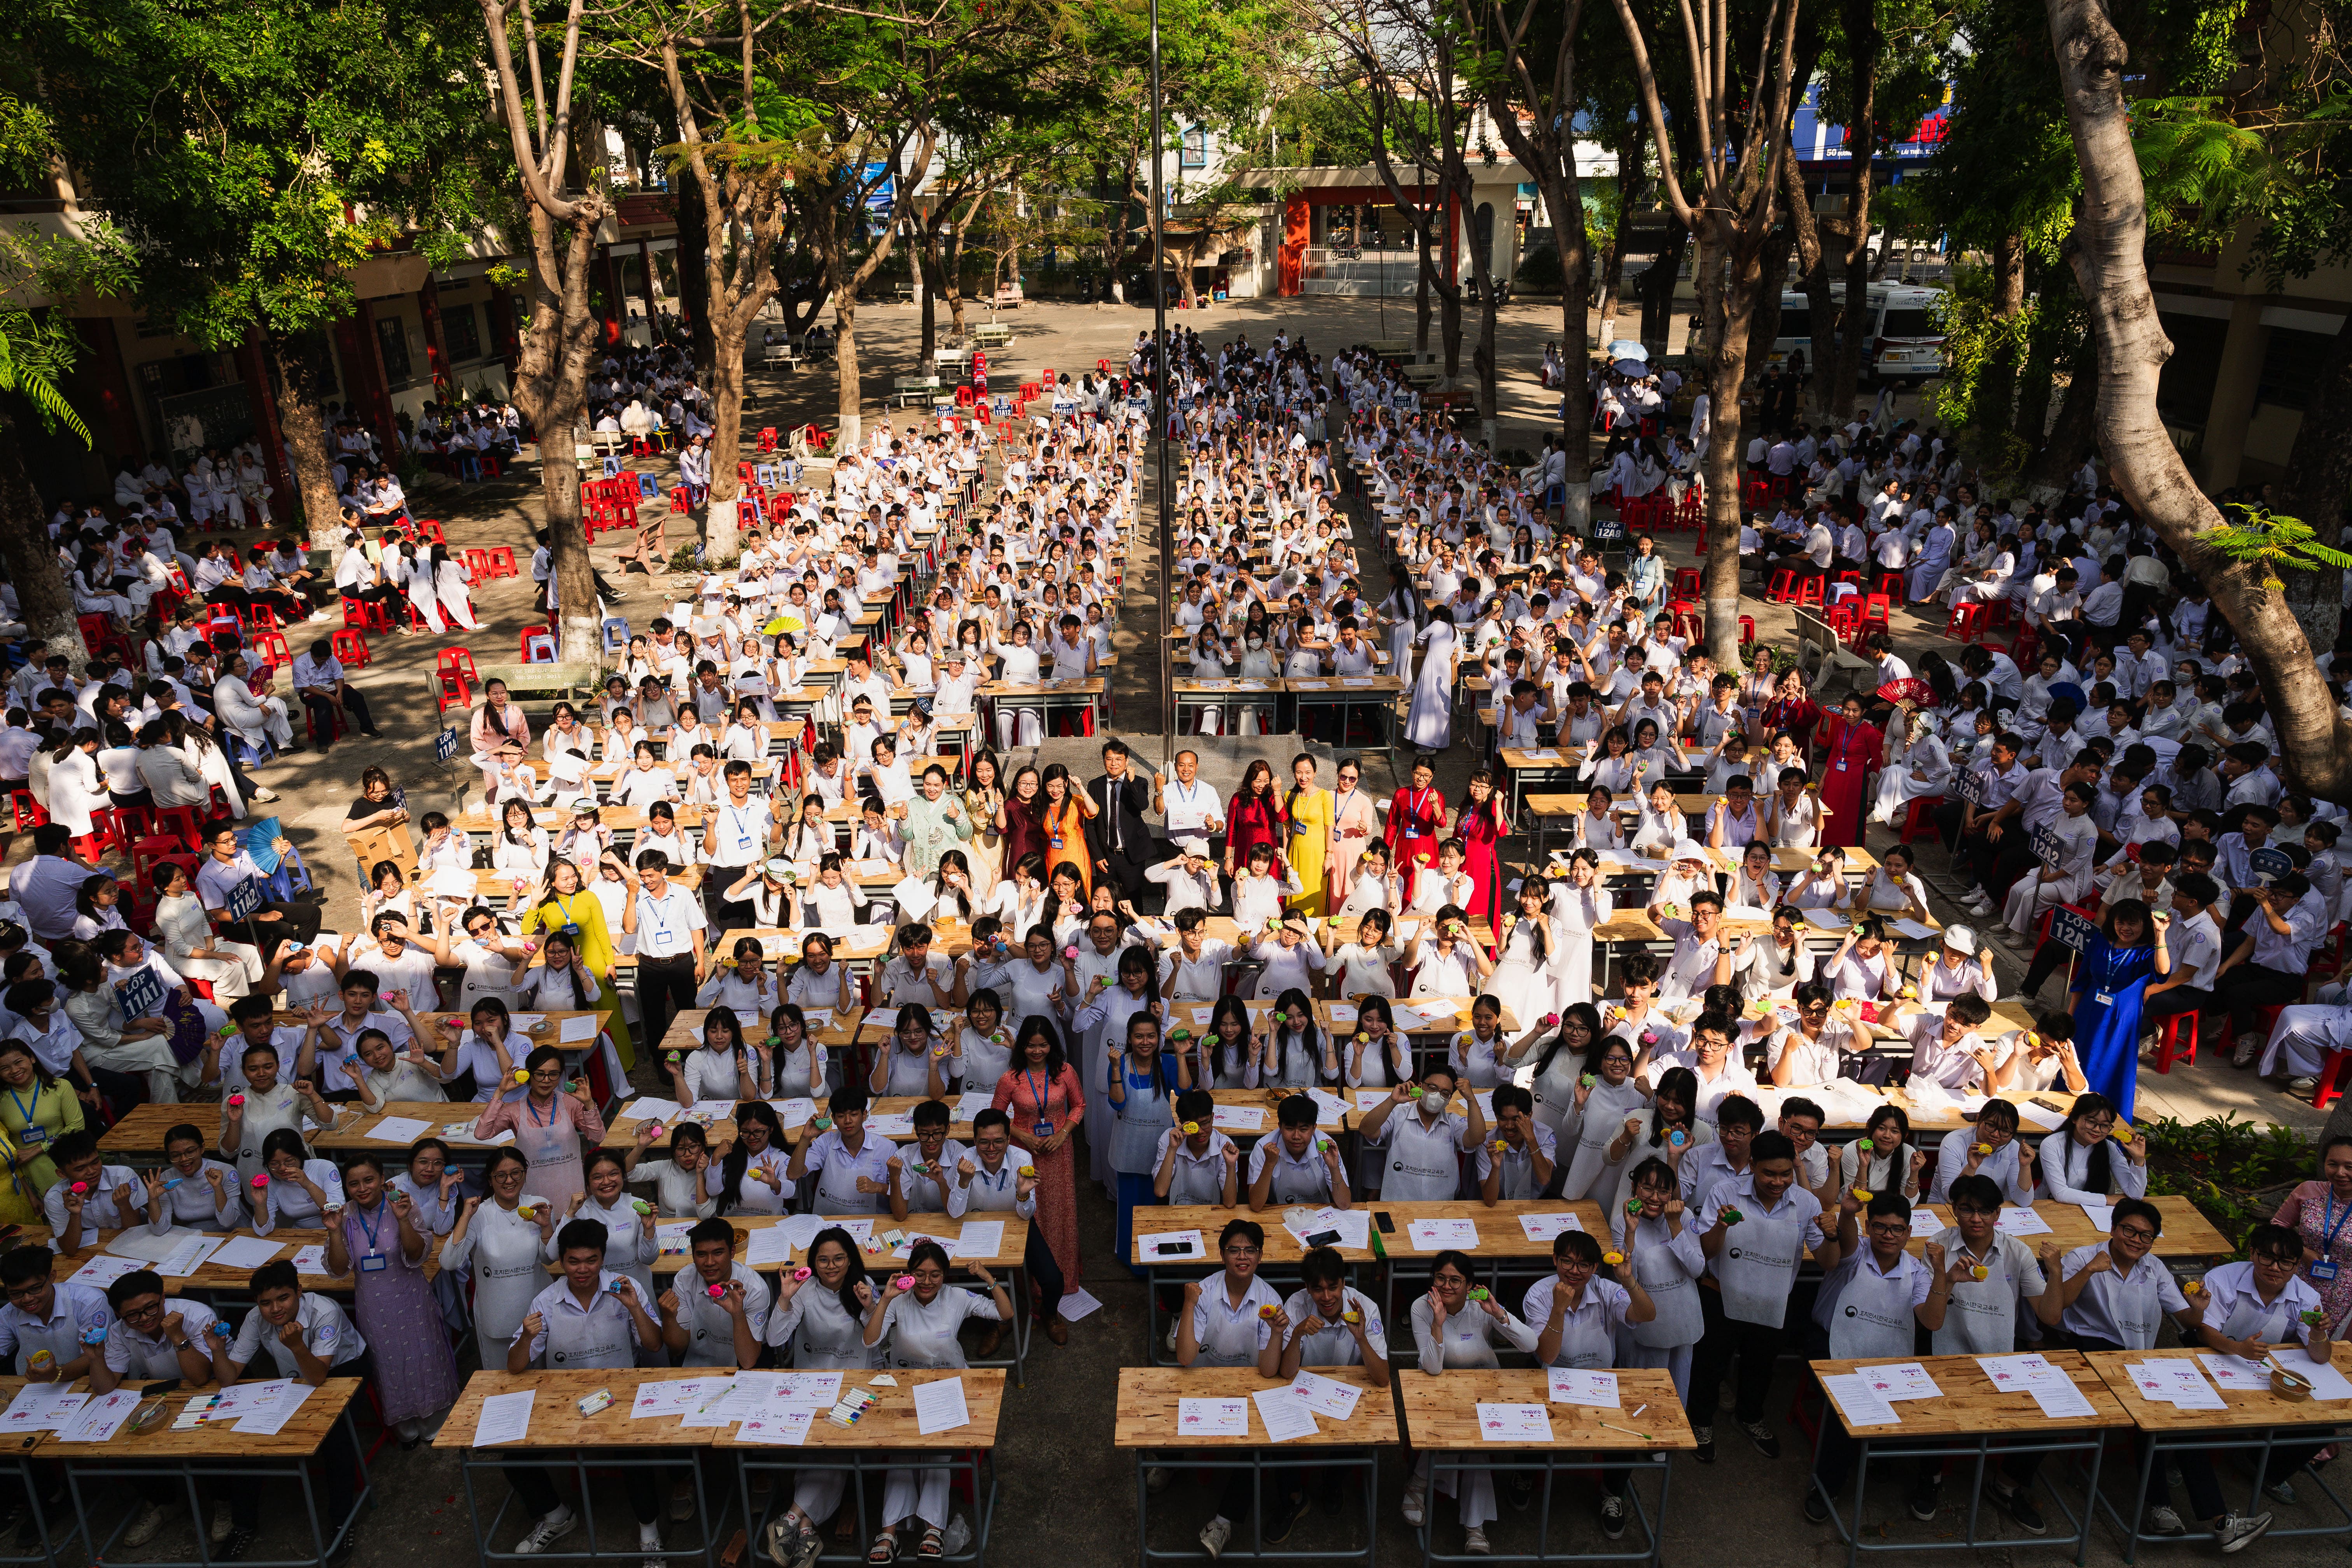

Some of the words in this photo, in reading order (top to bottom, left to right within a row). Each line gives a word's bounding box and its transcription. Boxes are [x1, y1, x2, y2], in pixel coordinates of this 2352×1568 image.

[1598, 528, 1621, 537] 12A8
[439, 732, 452, 744] LỚP
[439, 737, 457, 760] 11A4
[1964, 770, 1979, 784] LỚP
[1958, 779, 1979, 800] 12A3
[2039, 827, 2057, 845] LỚP
[2033, 837, 2059, 866] 12A2
[234, 880, 249, 900] LỚP
[233, 888, 257, 918] 11A2
[2064, 912, 2091, 931] LỚP
[126, 973, 145, 996] LỚP
[126, 981, 159, 1016] 11A1
[1122, 1114, 1160, 1124] 호치민시한국교육원
[531, 1153, 574, 1166] 호치민시한국교육원
[1405, 1164, 1444, 1174] 호치민시한국교육원
[827, 1193, 865, 1205] 호치민시한국교육원
[1744, 1250, 1791, 1264] 호치민시한국교육원
[494, 1264, 535, 1275] 호치민시한국교육
[1859, 1310, 1902, 1326] 호치민시한국교육원
[569, 1344, 616, 1357] 호치민시한국교육원
[1558, 1352, 1597, 1362] 치민시한국교육원
[1335, 1387, 1354, 1396] 수고했어요
